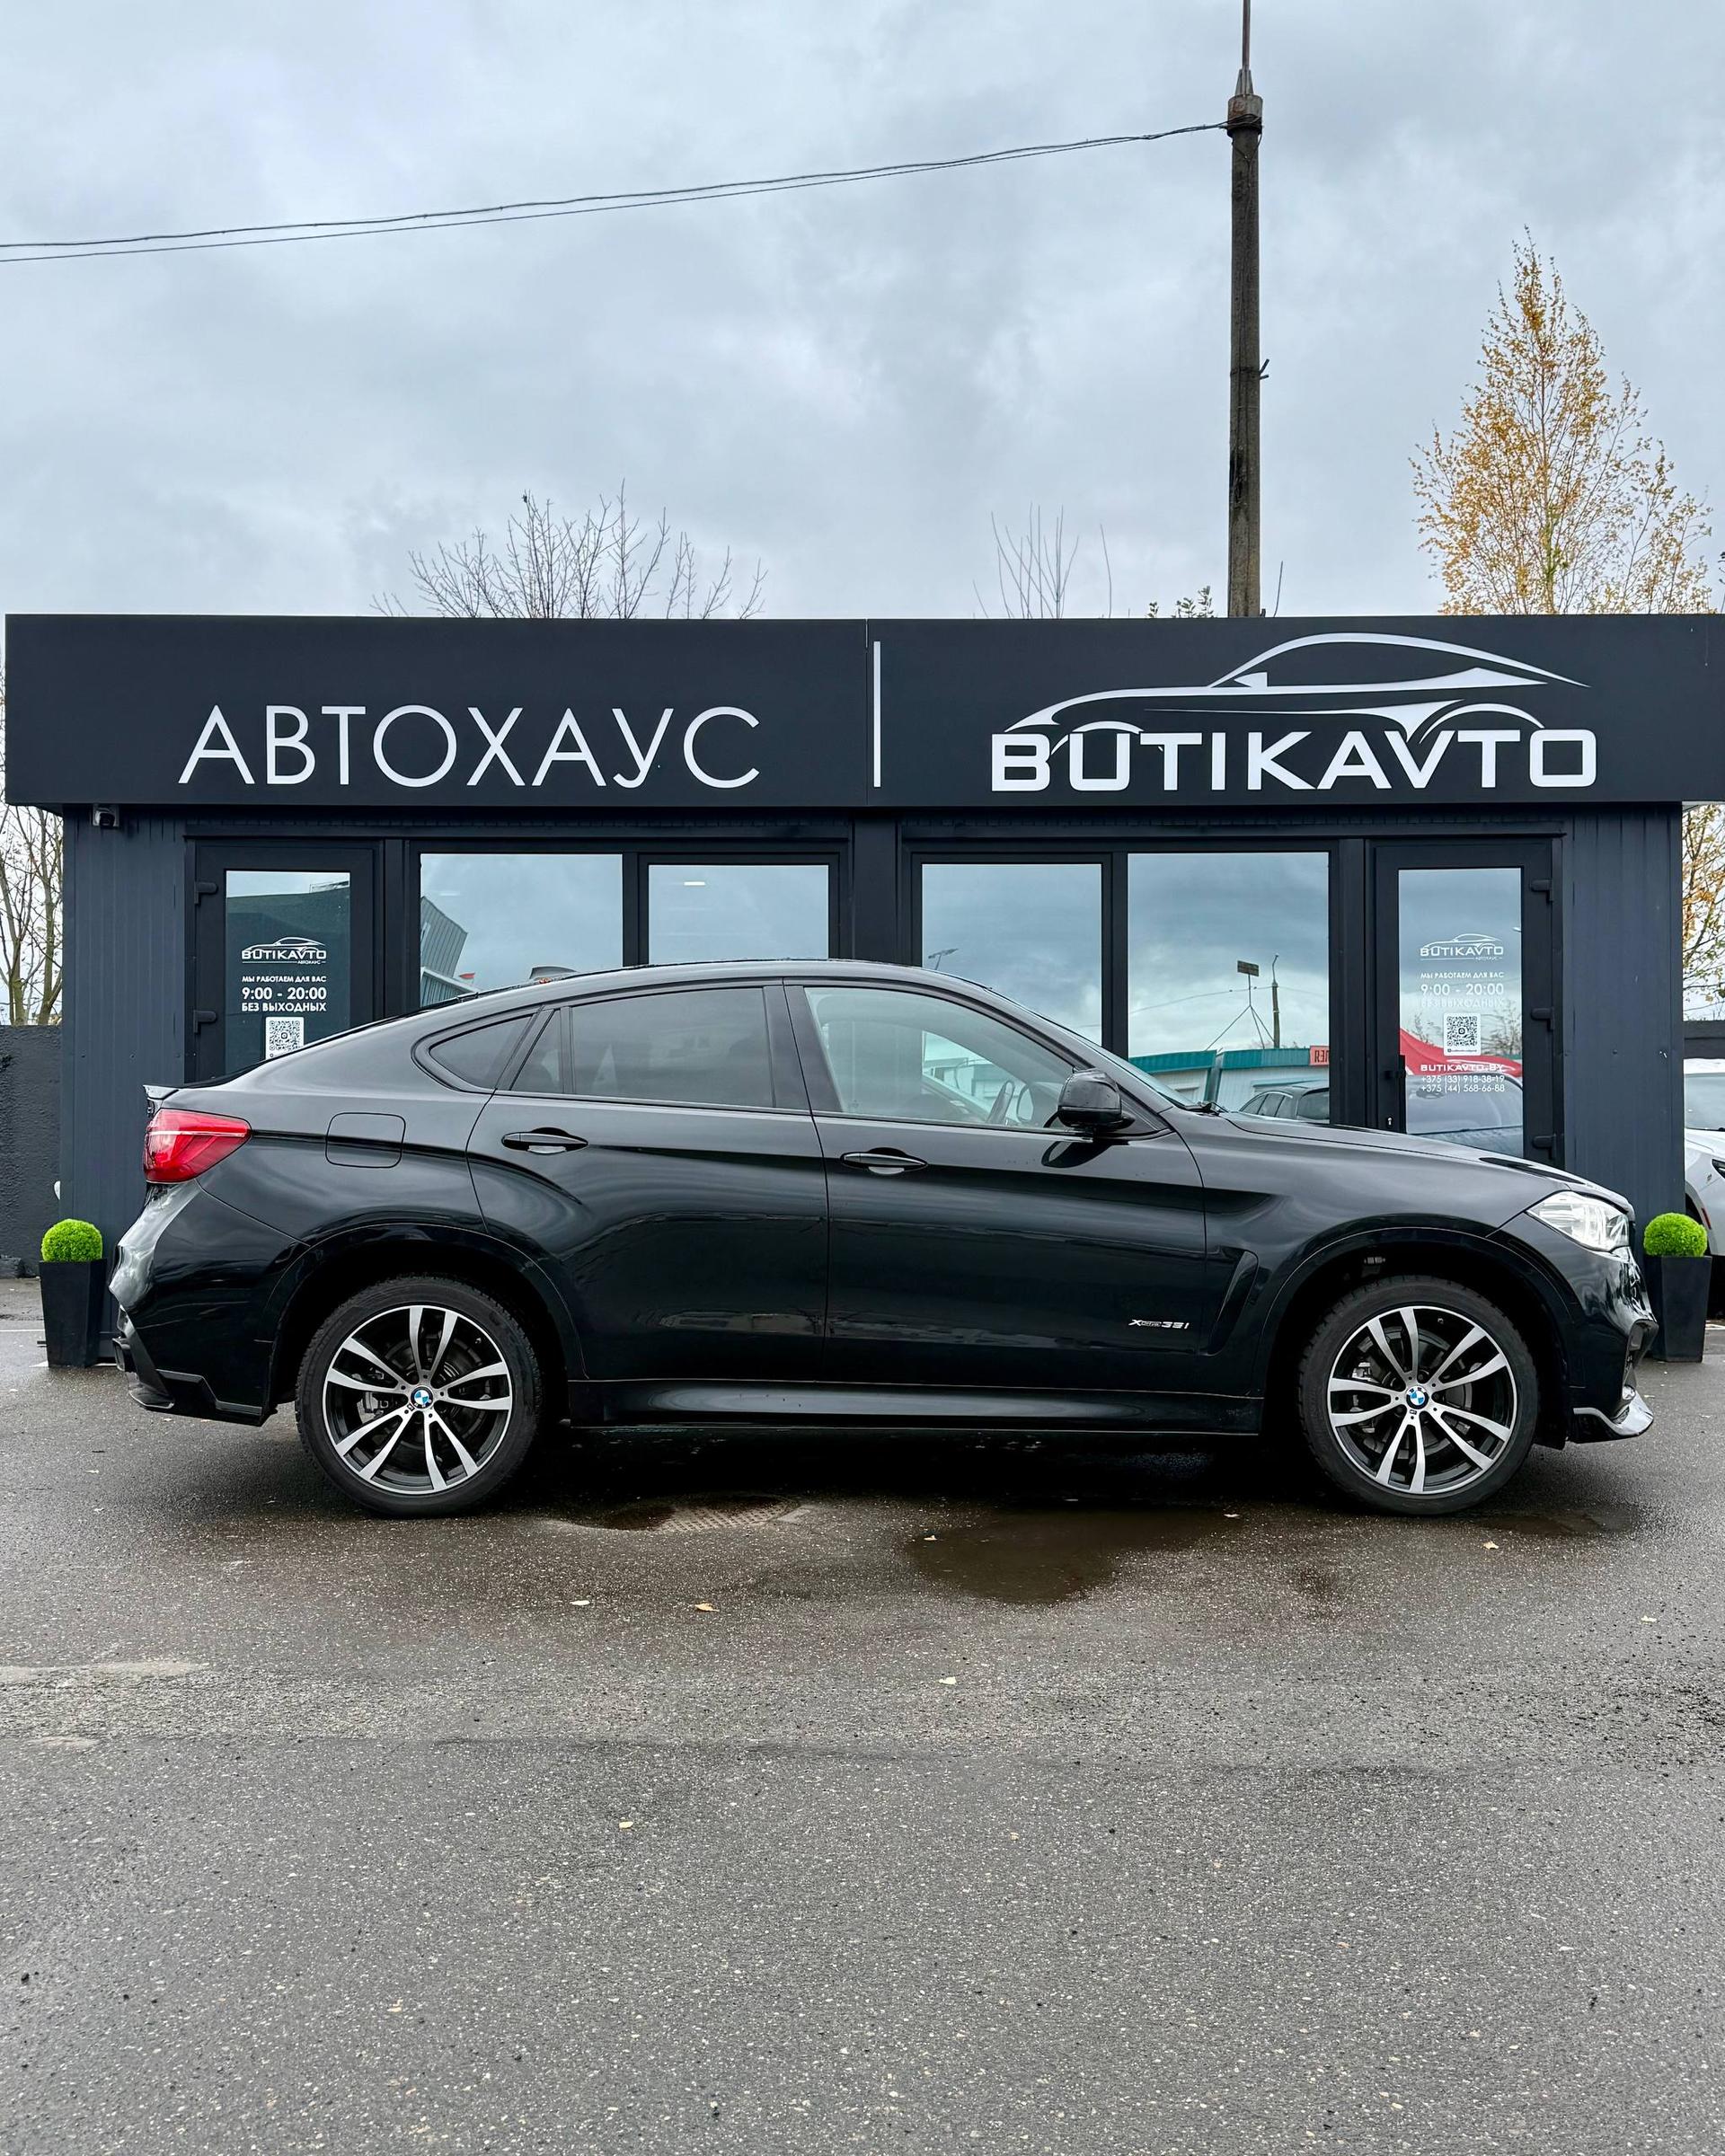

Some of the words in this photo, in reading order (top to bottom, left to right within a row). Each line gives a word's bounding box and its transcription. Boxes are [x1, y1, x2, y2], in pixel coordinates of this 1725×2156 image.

[178, 704, 761, 789] АВТОХАУС
[991, 728, 1597, 792] BUTIKAVTO
[242, 950, 327, 959] BUTIKAVTO
[1420, 946, 1504, 957] BUTIKAVTO
[295, 976, 310, 984] ДЛЯ
[242, 986, 273, 1000] 9:00
[287, 986, 327, 1000] 20:00
[1420, 984, 1450, 995] 9:00
[1465, 983, 1504, 995] 20:00
[242, 1003, 260, 1012] БЕЗ
[262, 1003, 327, 1012] ВЫХОДНЫХ
[1420, 1064, 1506, 1073] BUTIKAVTO.BY
[1444, 1074, 1461, 1084] (33)
[1463, 1074, 1505, 1082] 918-38-19
[1421, 1084, 1442, 1092] +375
[1444, 1083, 1461, 1093] (44)
[1463, 1084, 1505, 1092] 568-66-88
